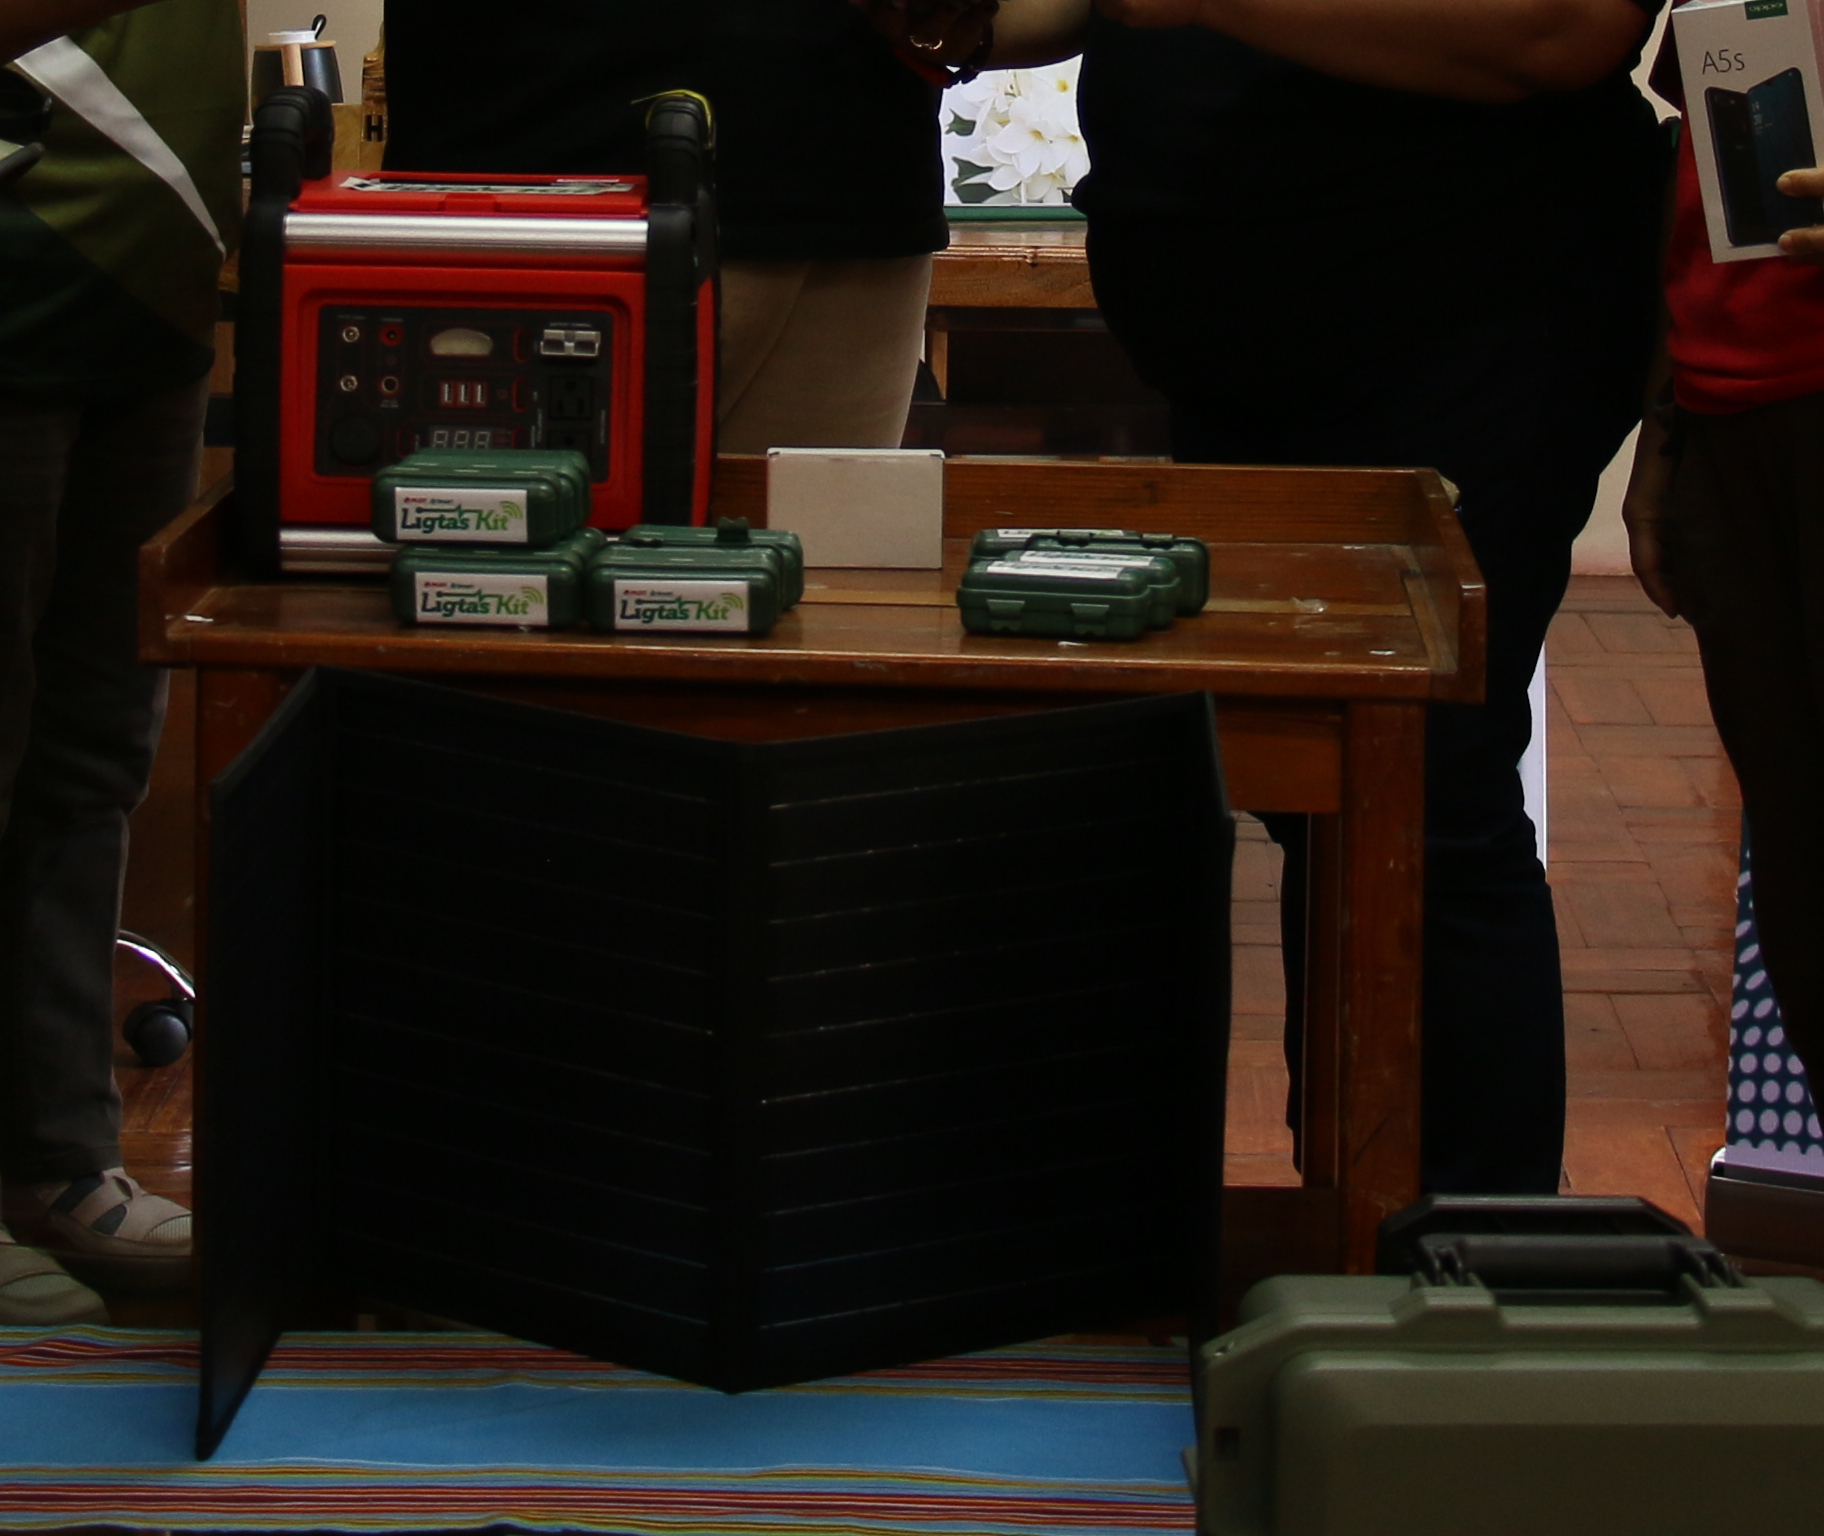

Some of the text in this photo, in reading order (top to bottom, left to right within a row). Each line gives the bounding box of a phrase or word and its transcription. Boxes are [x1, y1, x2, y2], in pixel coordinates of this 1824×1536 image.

[1702, 49, 1745, 75] A5s
[401, 507, 510, 534] Ligtas Kit
[421, 591, 530, 617] Ligtas Kit
[620, 599, 730, 624] Ligtas Kit
